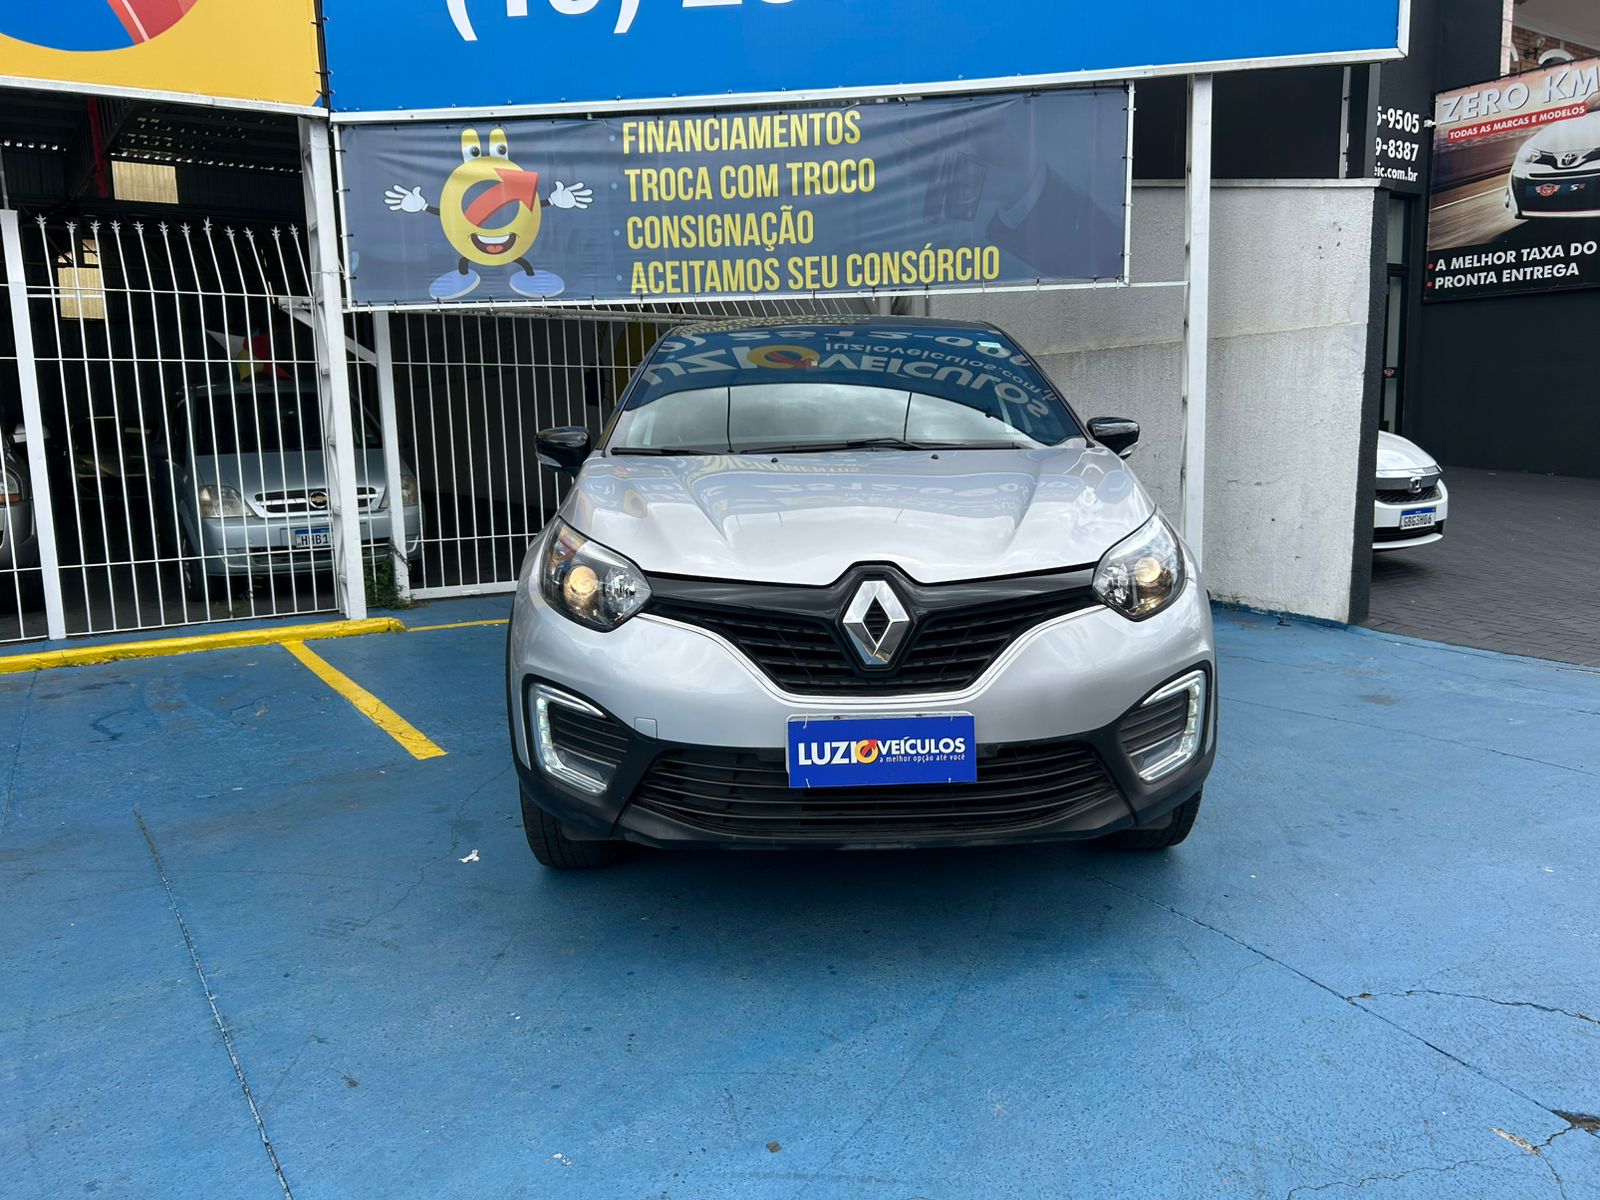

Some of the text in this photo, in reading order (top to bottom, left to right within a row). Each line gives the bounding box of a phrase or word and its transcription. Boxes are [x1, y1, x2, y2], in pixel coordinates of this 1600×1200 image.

[1440, 66, 1600, 125] ZERO KM
[623, 110, 862, 154] FINANCIAMENTOS
[1449, 106, 1585, 139] TODAS AS MARCAS E MODELOS
[624, 157, 876, 202] TROCA COM TROCO
[627, 205, 814, 251] CONSIGNAÇÃO
[630, 242, 1000, 294] ACEITAMOS SEU CONSÓRCIO
[1435, 240, 1598, 271] A MELHOR TAXA DO
[1435, 262, 1579, 289] PRONTA ENTREGA
[877, 736, 966, 756] VEÍCULOS
[886, 755, 911, 763] melhor
[913, 754, 934, 763] opção
[949, 753, 965, 761] você
